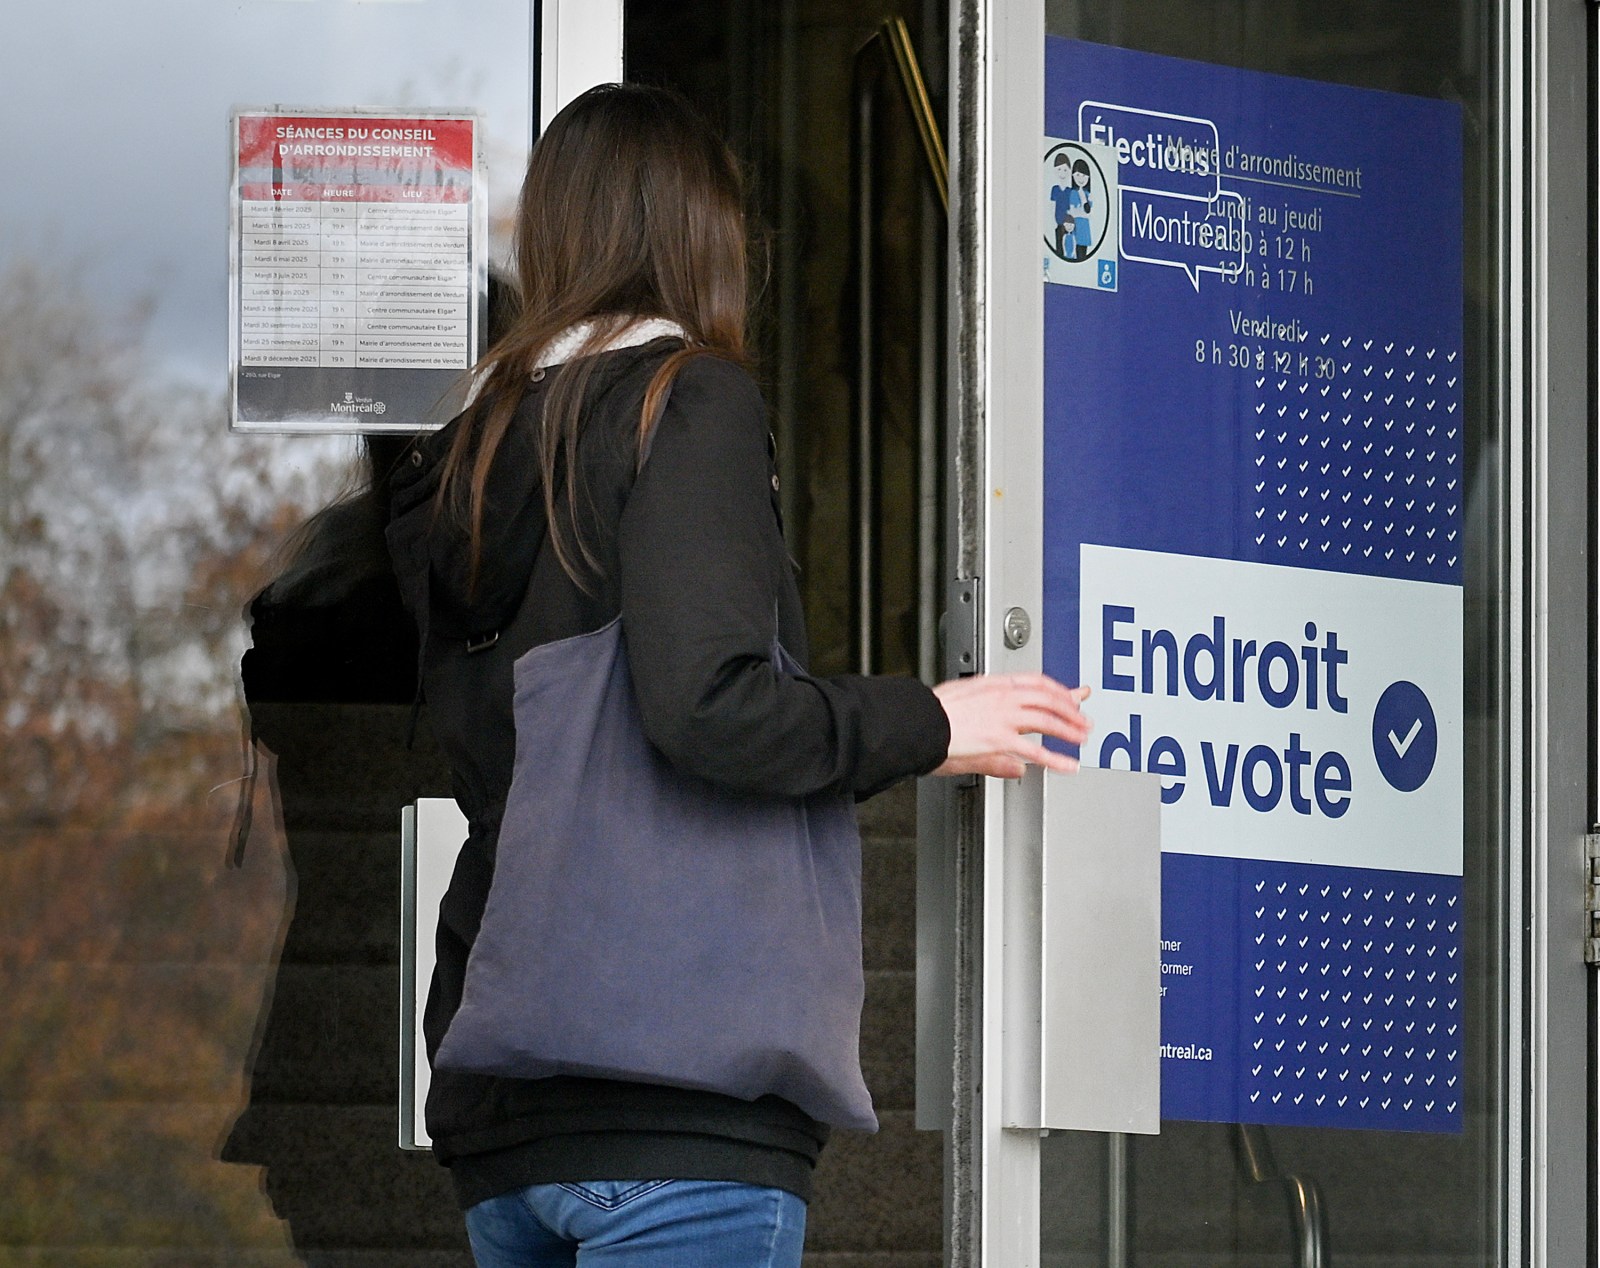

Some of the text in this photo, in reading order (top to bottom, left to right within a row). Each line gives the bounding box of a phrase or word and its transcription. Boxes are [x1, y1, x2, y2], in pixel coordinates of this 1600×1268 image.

[276, 124, 436, 141] SÉANCES DU CONSEIL
[1090, 116, 1209, 176] Élections
[279, 144, 433, 158] D'ARRONDISSEMENT
[1167, 135, 1362, 189] Mairie d'arrondissement
[271, 188, 292, 196] DATE
[323, 189, 353, 197] HEURE
[1131, 201, 1235, 251] Montréal
[1207, 192, 1323, 233] Lundi au jeudi
[1232, 229, 1253, 254] 30
[1258, 231, 1268, 257] à
[1276, 236, 1295, 261] 12
[1302, 237, 1311, 263] h
[1219, 260, 1313, 295] 13 h à 17 h
[1229, 310, 1301, 344] Vendredi
[1195, 339, 1336, 380] 8 h 30 à 12 h 30
[331, 402, 373, 413] Montréal
[1102, 603, 1349, 714] Endroit
[1099, 714, 1352, 819] de vote
[1160, 940, 1182, 951] nner
[1160, 961, 1193, 976] ormer
[1160, 1043, 1213, 1061] ntreal.ca
